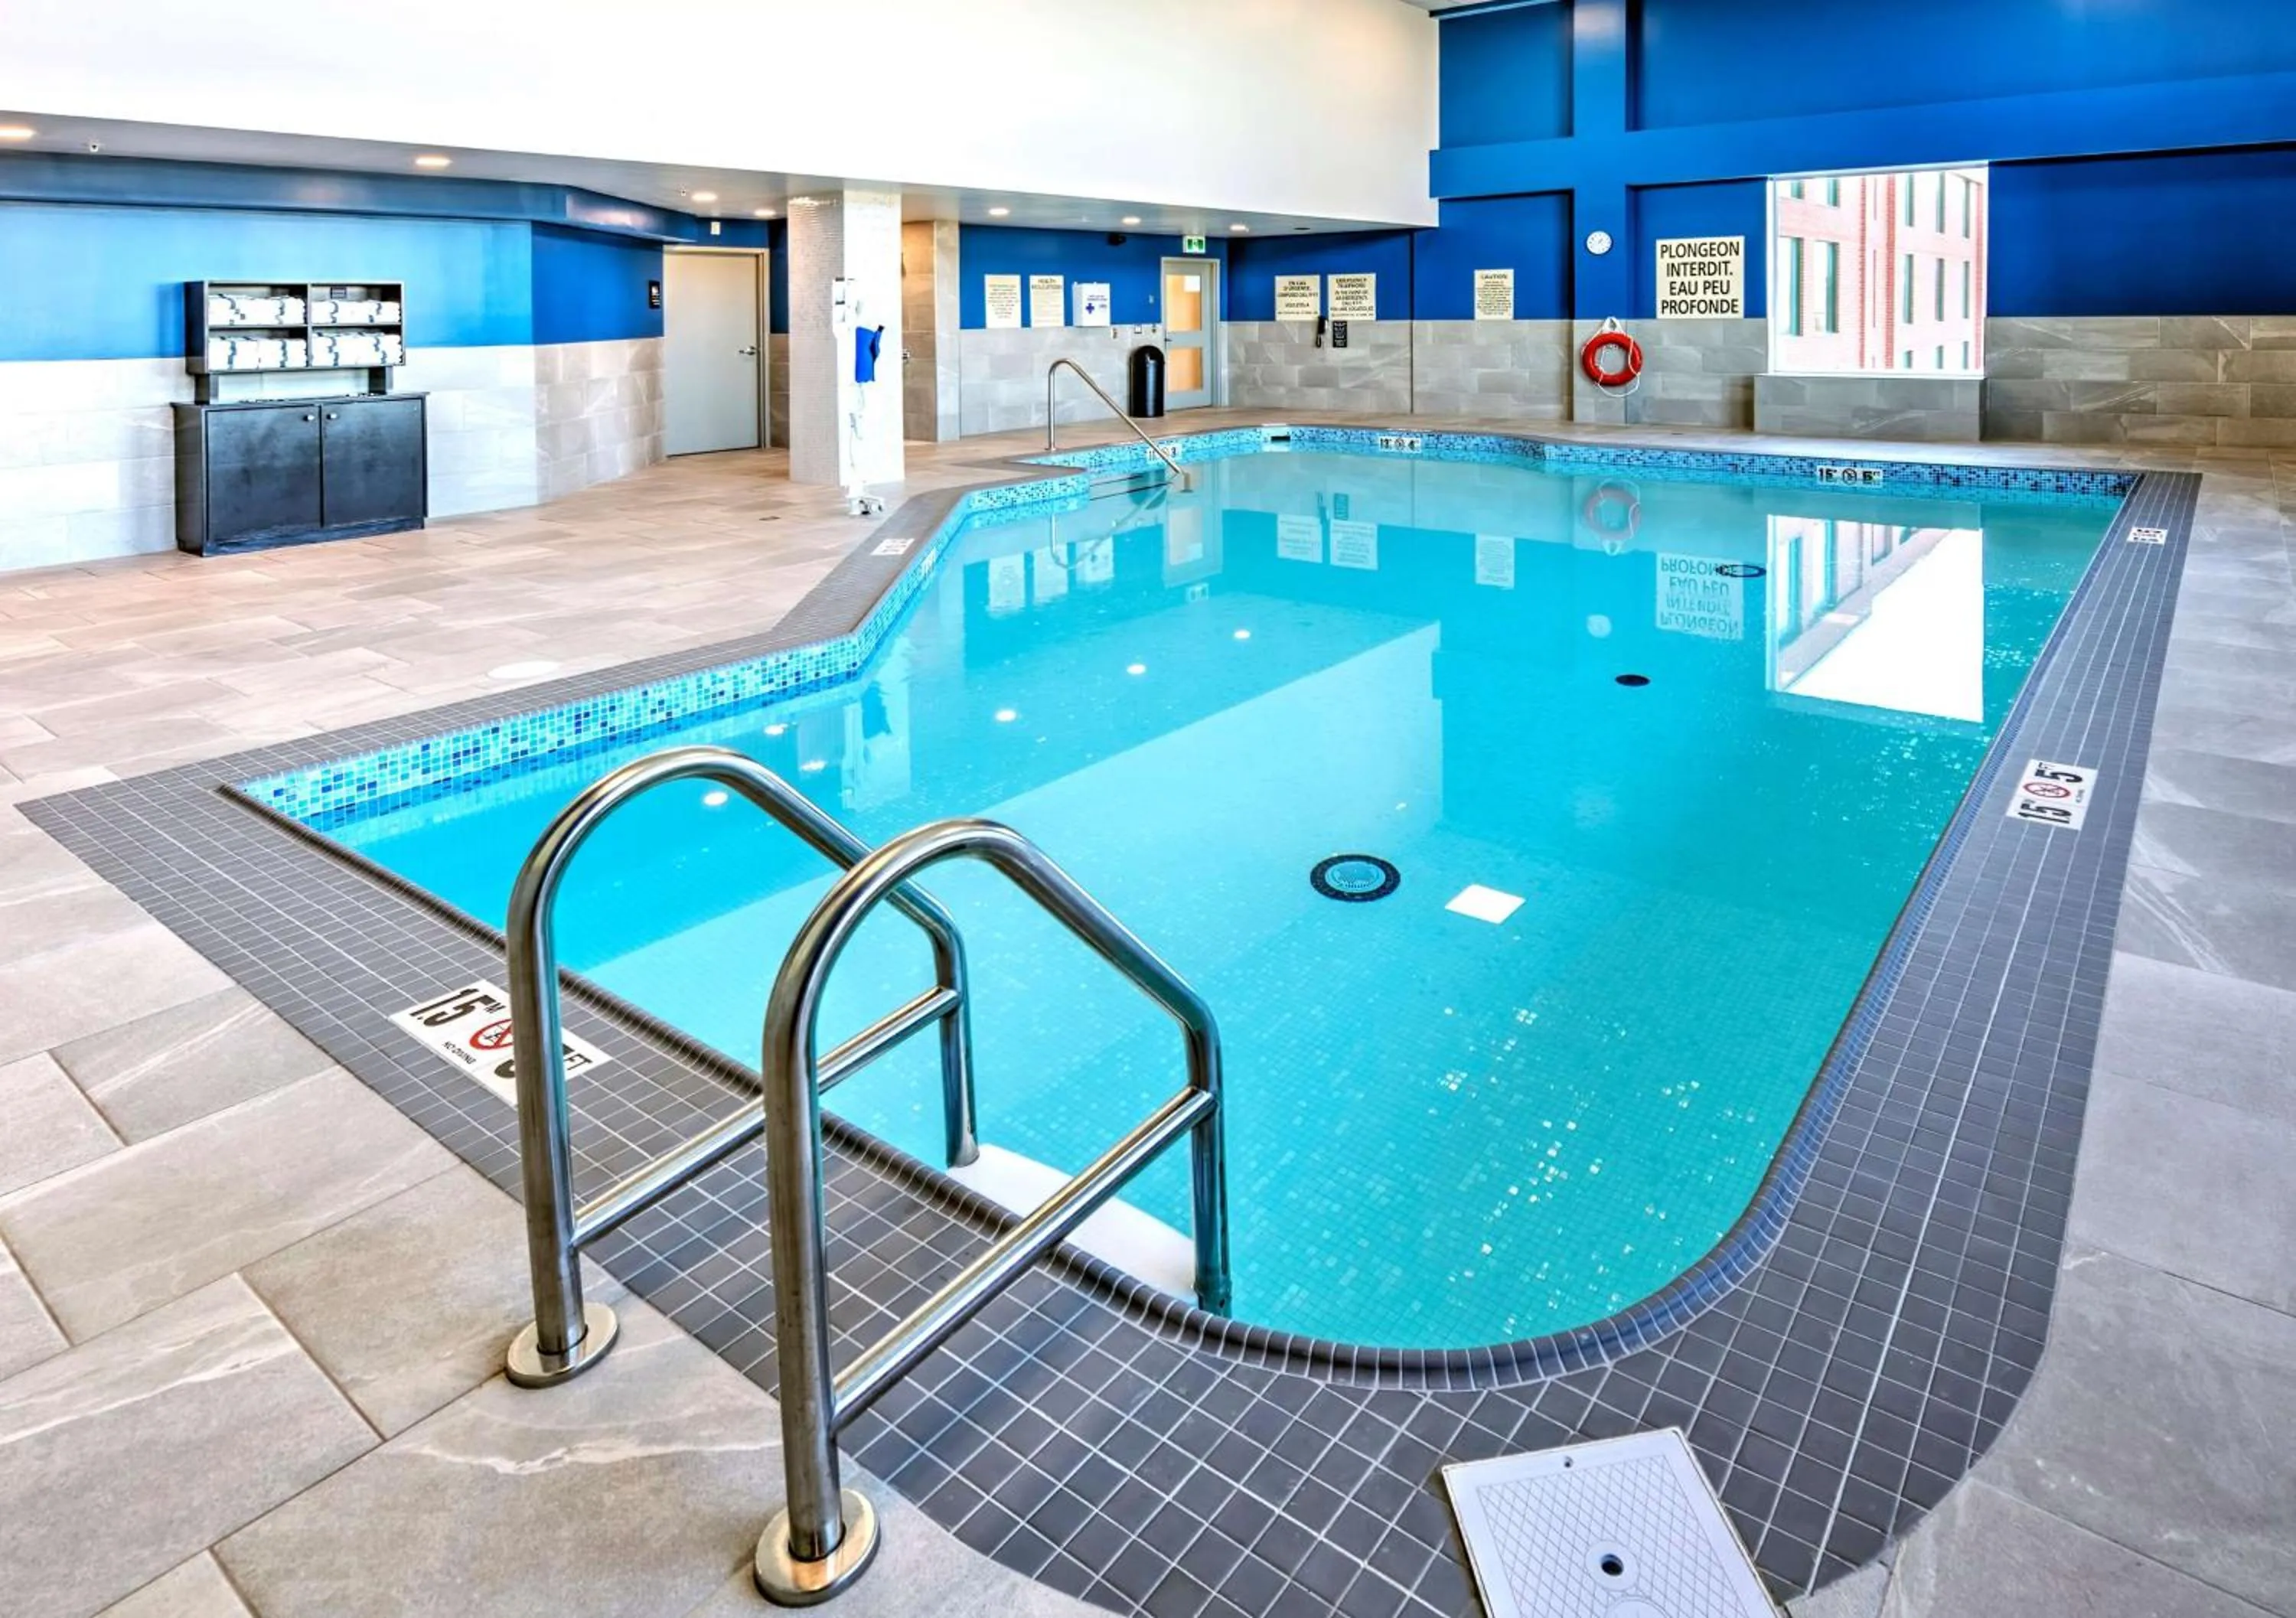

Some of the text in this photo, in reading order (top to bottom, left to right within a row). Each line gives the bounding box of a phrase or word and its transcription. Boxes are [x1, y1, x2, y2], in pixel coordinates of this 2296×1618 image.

[1660, 241, 1740, 259] PLONGEON
[1666, 260, 1733, 277] INTERDIT.
[1669, 279, 1730, 296] EAU PEU
[1661, 298, 1740, 315] PROFONDE
